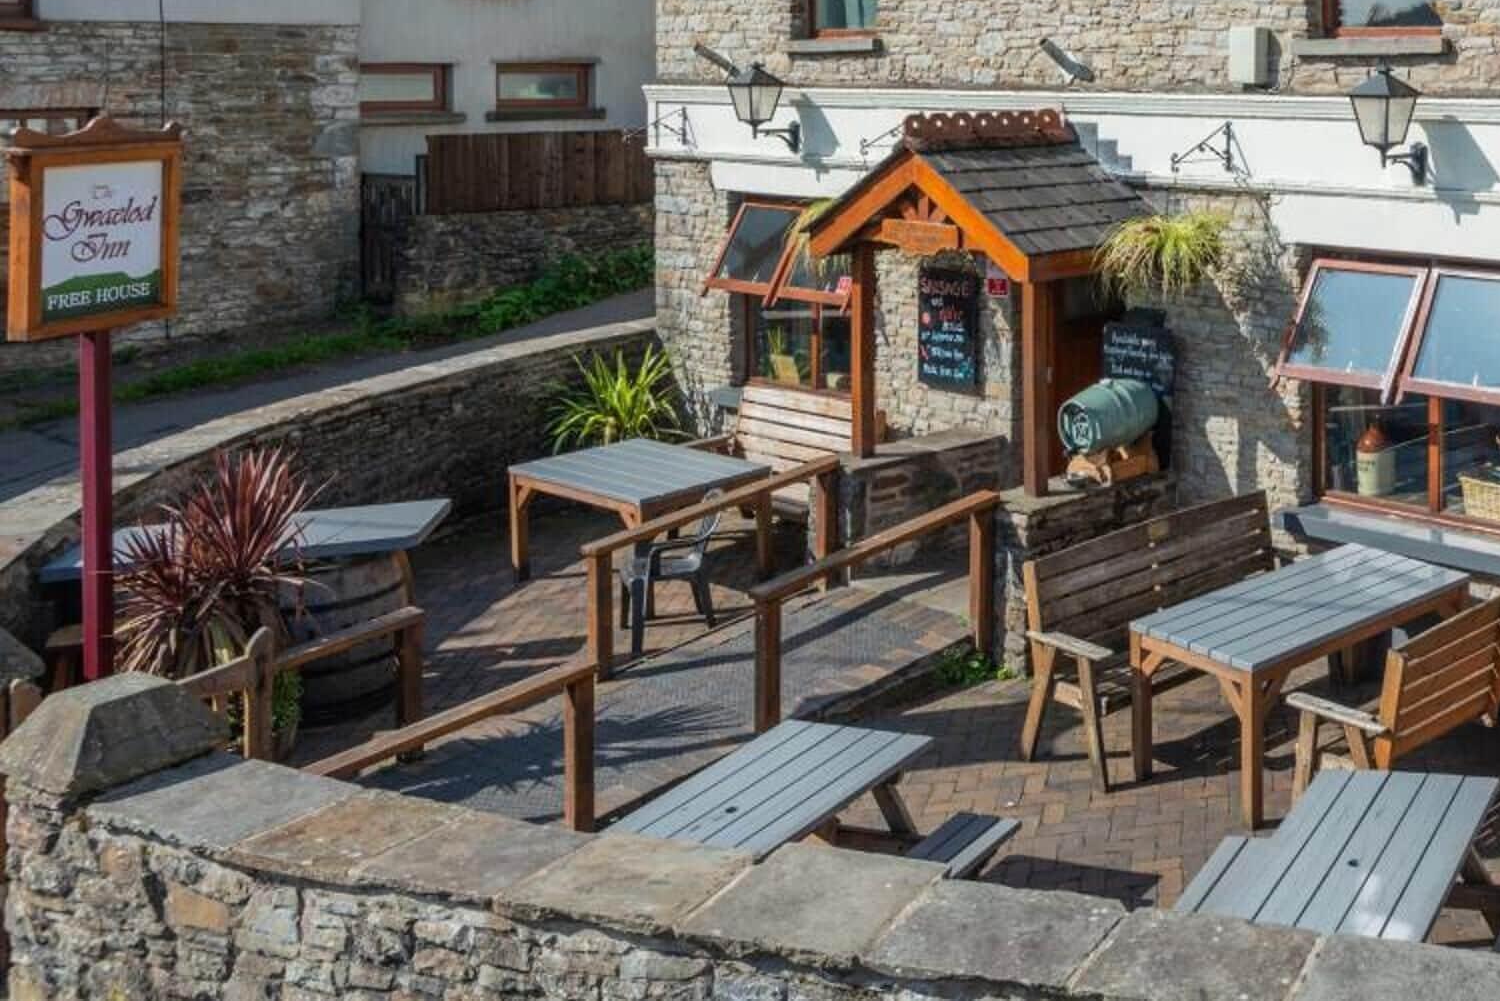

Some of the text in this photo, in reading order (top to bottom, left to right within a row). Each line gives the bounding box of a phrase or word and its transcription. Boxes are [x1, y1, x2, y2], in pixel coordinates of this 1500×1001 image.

[43, 195, 157, 241] Gwaelod
[71, 232, 131, 262] Inn
[47, 282, 151, 311] FREE HOUSE
